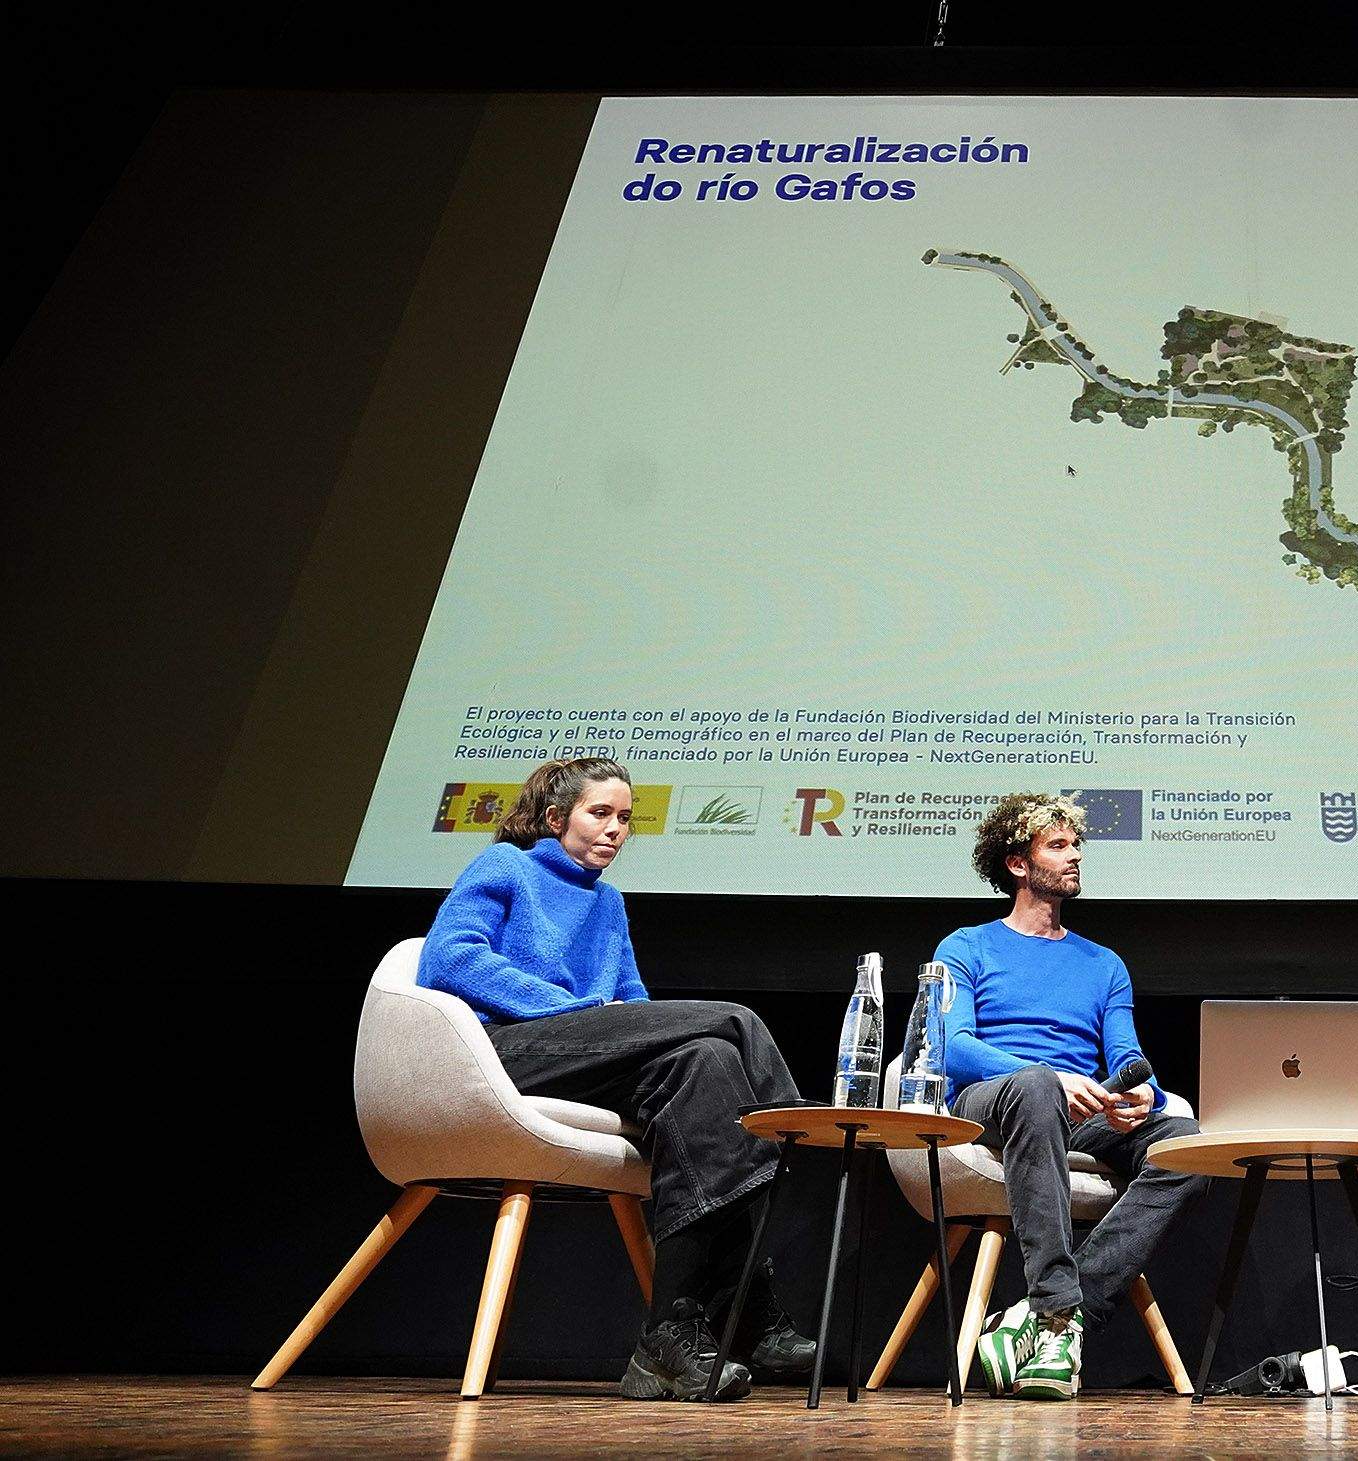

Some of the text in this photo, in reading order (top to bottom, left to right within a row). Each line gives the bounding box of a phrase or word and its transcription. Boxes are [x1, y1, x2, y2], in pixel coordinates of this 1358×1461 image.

[634, 136, 1029, 164] Renaturalización
[622, 172, 916, 201] do río Gafos
[466, 706, 1296, 730] El proyecto cuenta con el apoyo de la Fundación Biodiversidad del Ministerio para la Transición
[460, 725, 1248, 749] Ecológica y el Reto Demográfico en el marco del Plan de Recuperación, Transformación y
[454, 744, 548, 760] Resiliencia
[553, 745, 619, 762] (PRTR),
[626, 745, 717, 762] financiado
[723, 750, 753, 766] por
[758, 748, 773, 762] la
[780, 747, 830, 763] Unión
[837, 748, 909, 767] Europea
[930, 749, 1098, 764] NextGenerationEU.
[854, 791, 890, 804] Plan
[894, 791, 916, 804] de
[1151, 789, 1274, 805] Financiado por
[852, 806, 983, 821] Transformación
[1151, 808, 1292, 824] la Unión Europea
[851, 822, 957, 838] y Resiliencia
[1151, 829, 1277, 842] NextGenerationEU
